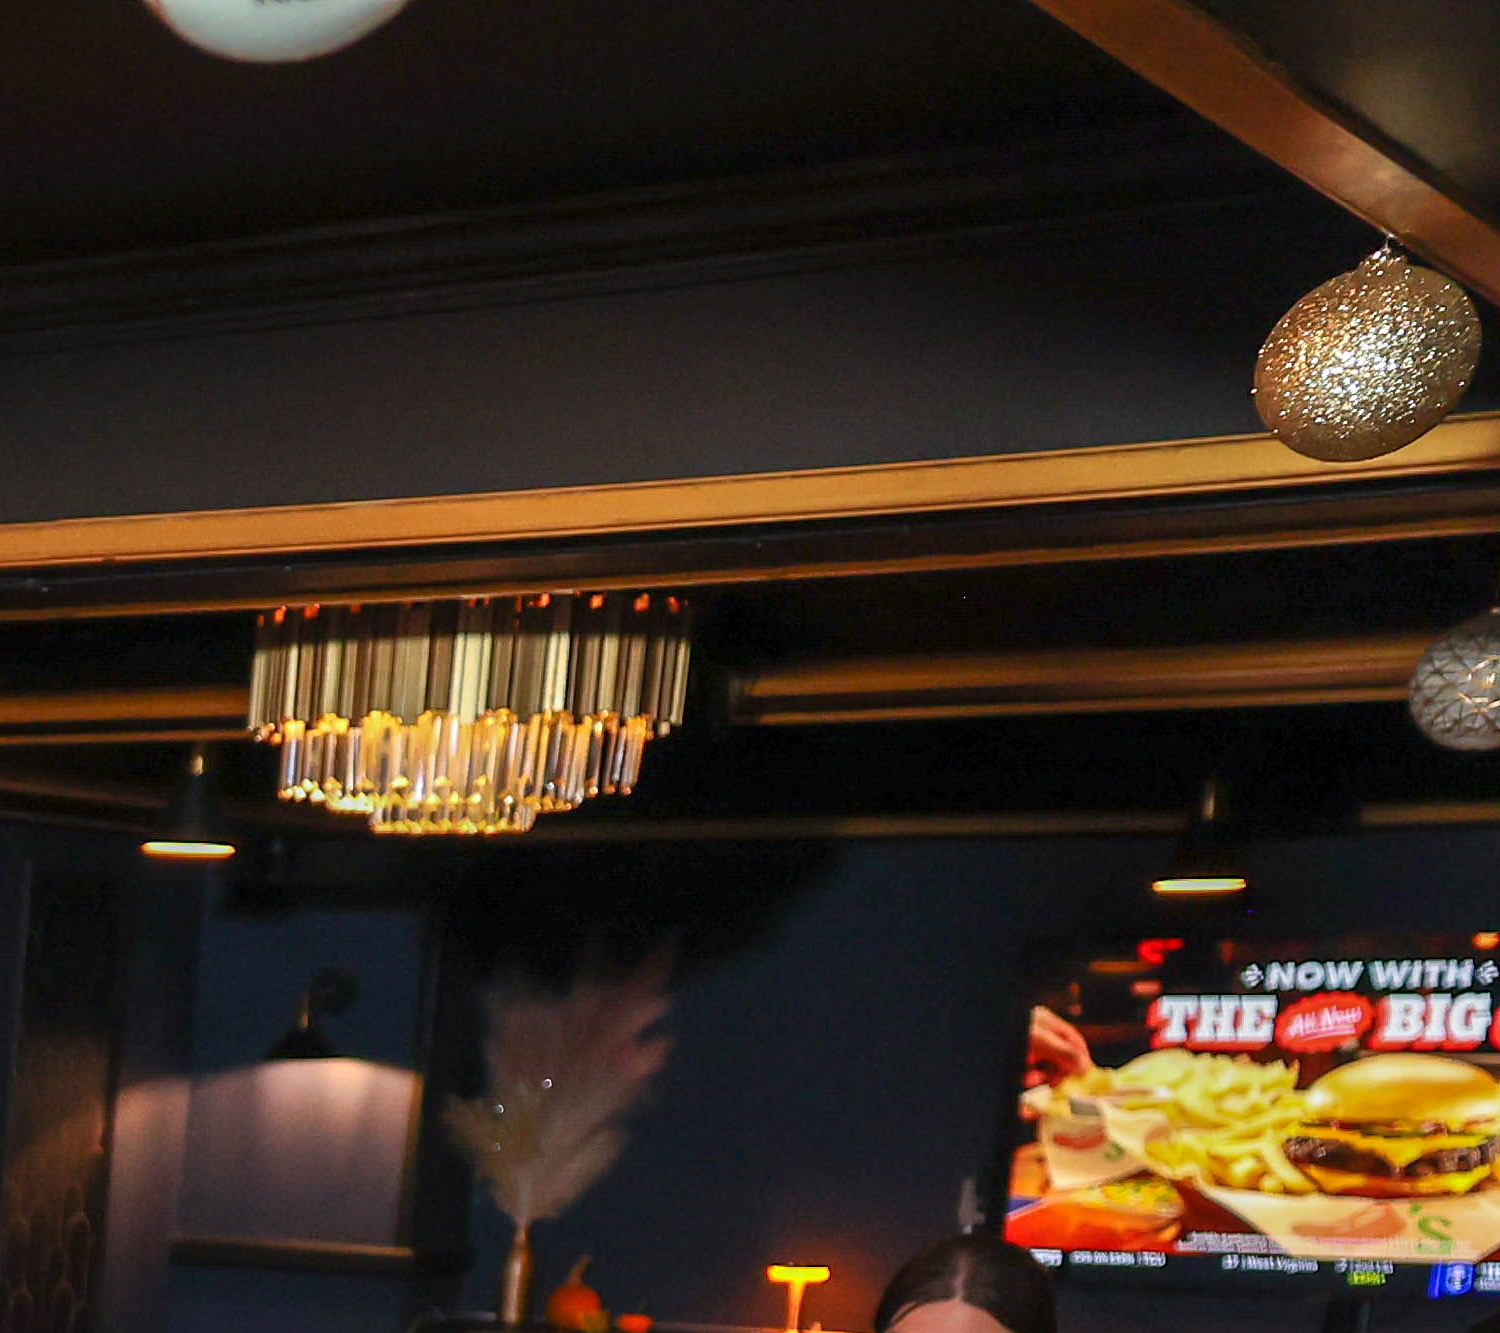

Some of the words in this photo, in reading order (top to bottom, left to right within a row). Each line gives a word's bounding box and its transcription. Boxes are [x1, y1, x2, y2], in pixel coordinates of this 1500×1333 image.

[1263, 960, 1364, 991] NOW
[1370, 958, 1475, 990] WITH
[1154, 995, 1278, 1043] THE
[1382, 992, 1492, 1043] BIG
